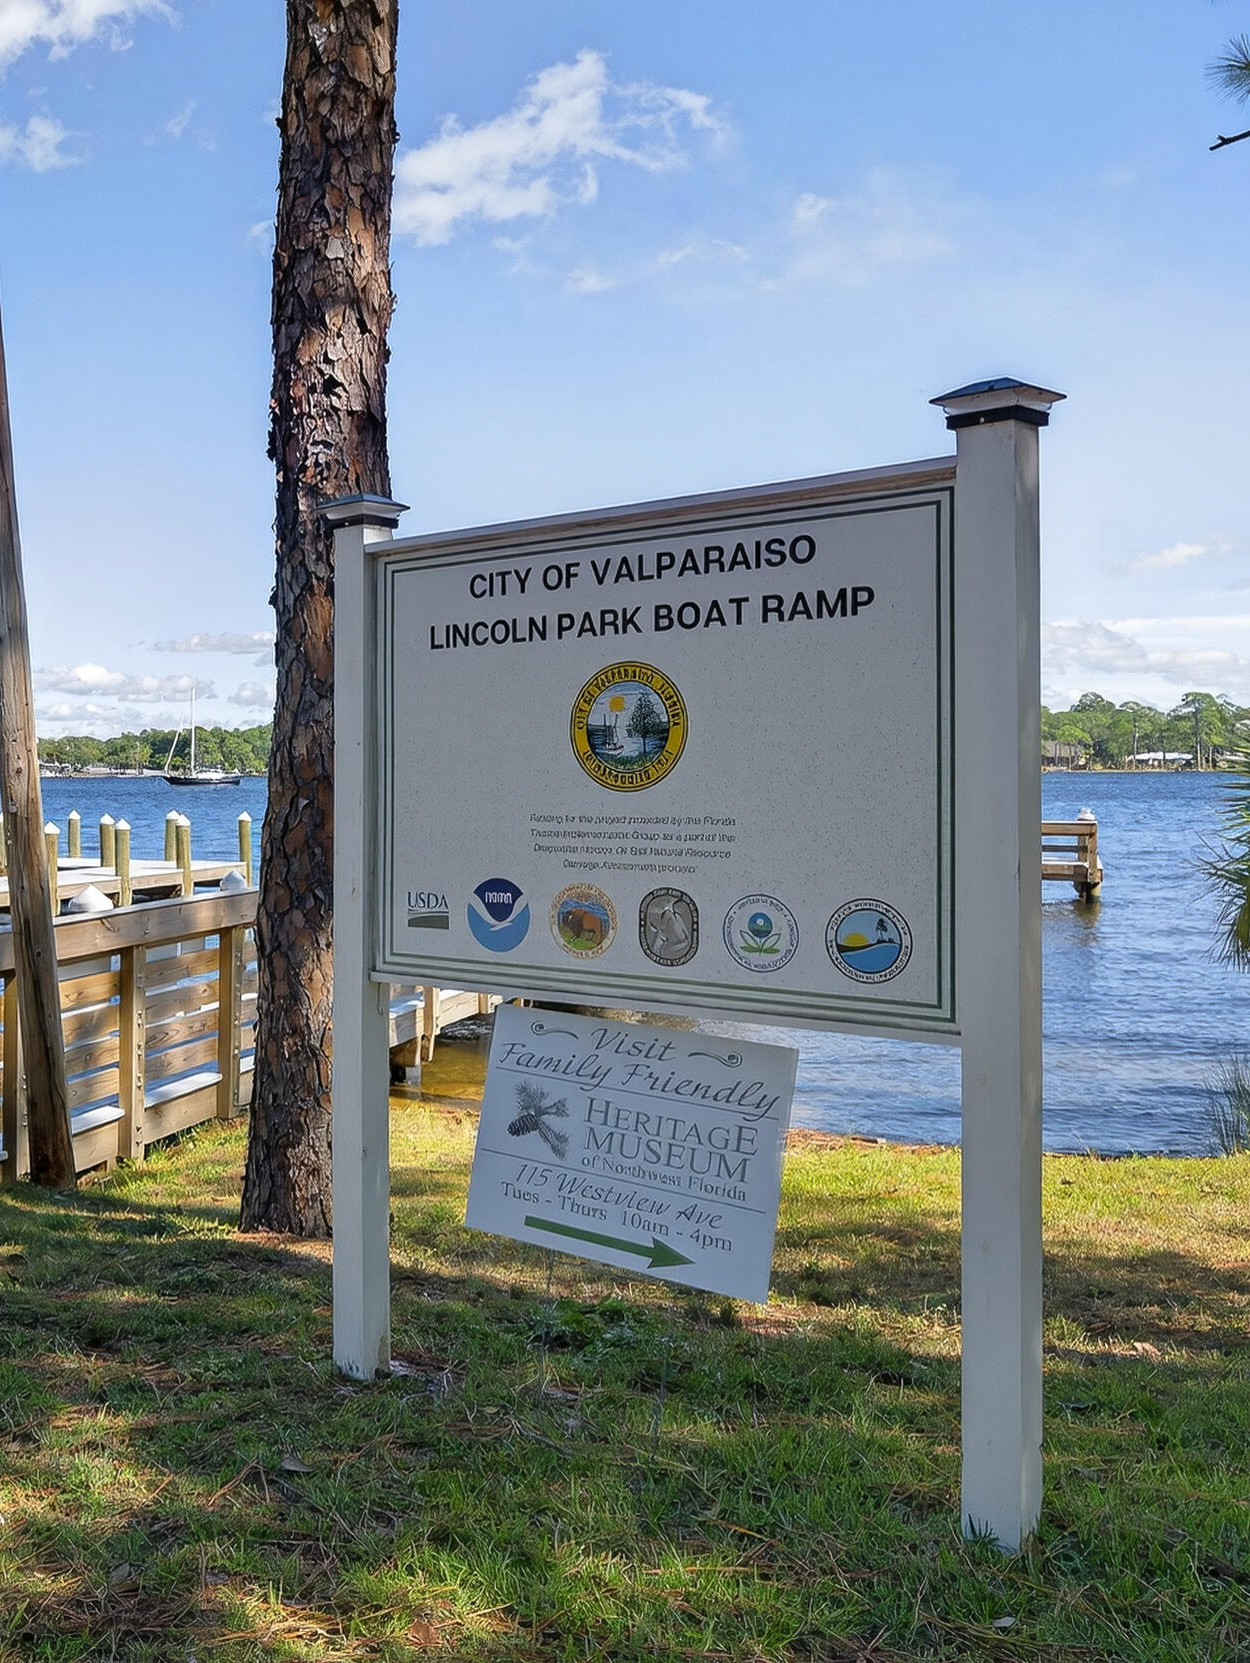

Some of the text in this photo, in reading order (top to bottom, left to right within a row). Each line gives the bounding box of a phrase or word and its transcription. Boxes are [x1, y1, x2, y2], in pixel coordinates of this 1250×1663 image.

[469, 535, 816, 599] CITY OF VALPARAISO
[429, 586, 875, 650] LINCOLN PARK BOAT RAMP
[408, 892, 449, 909] USDA
[590, 1027, 676, 1062] Visit
[500, 1042, 780, 1122] Family Friendly
[583, 1096, 758, 1156] HERITAGE
[584, 1126, 751, 1184] MUSEUM
[516, 1163, 724, 1229] 115 Westview Ave
[581, 1154, 601, 1168] of
[688, 1176, 747, 1202] Florida
[501, 1181, 539, 1204] Tues
[558, 1194, 608, 1221] Thurs
[622, 1210, 669, 1236] 10am
[689, 1229, 733, 1252] 4pm
